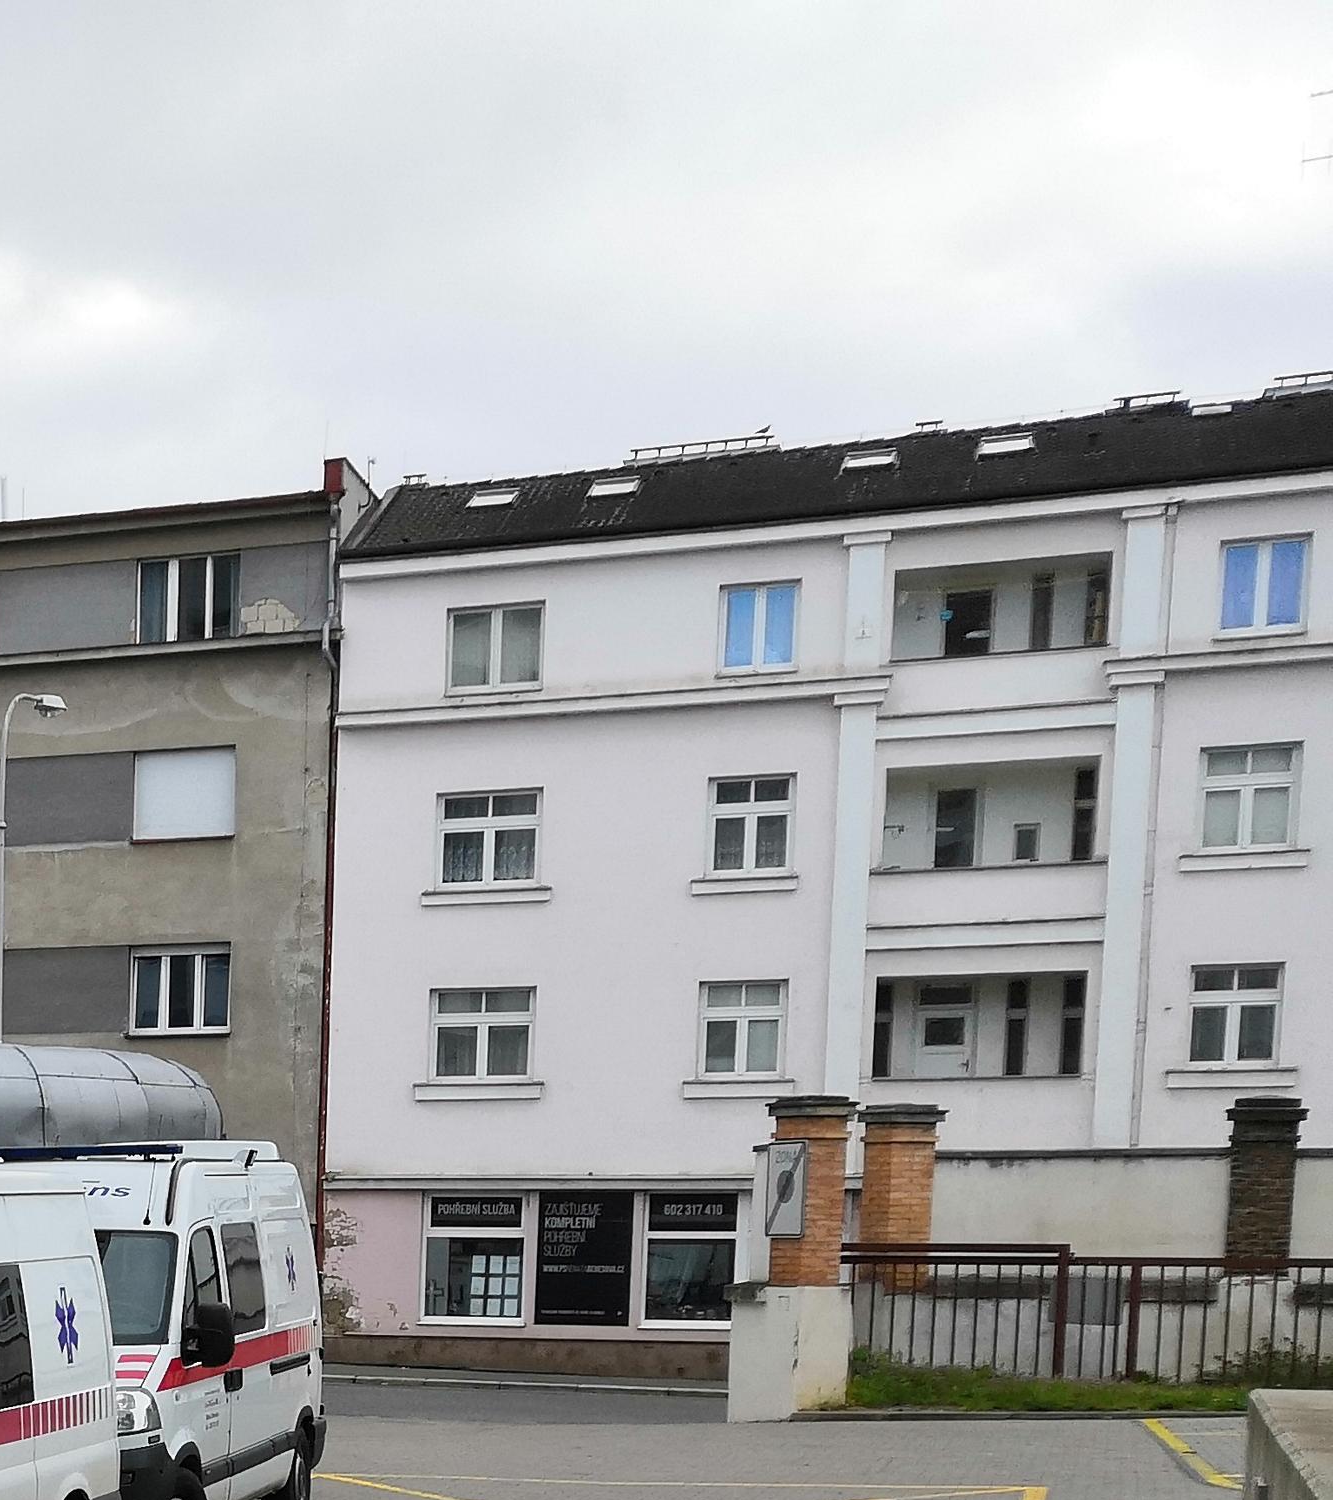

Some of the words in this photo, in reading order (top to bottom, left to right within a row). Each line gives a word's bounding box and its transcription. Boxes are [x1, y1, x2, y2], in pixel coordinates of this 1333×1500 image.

[437, 1201, 480, 1215] POHŘEBNÍ
[482, 1202, 515, 1215] SLUŽBA
[663, 1204, 683, 1216] 602
[684, 1203, 703, 1216] 317
[704, 1203, 723, 1216] 410
[544, 1215, 596, 1229] KOMPLETNÍ
[543, 1244, 578, 1257] SLUŽBY
